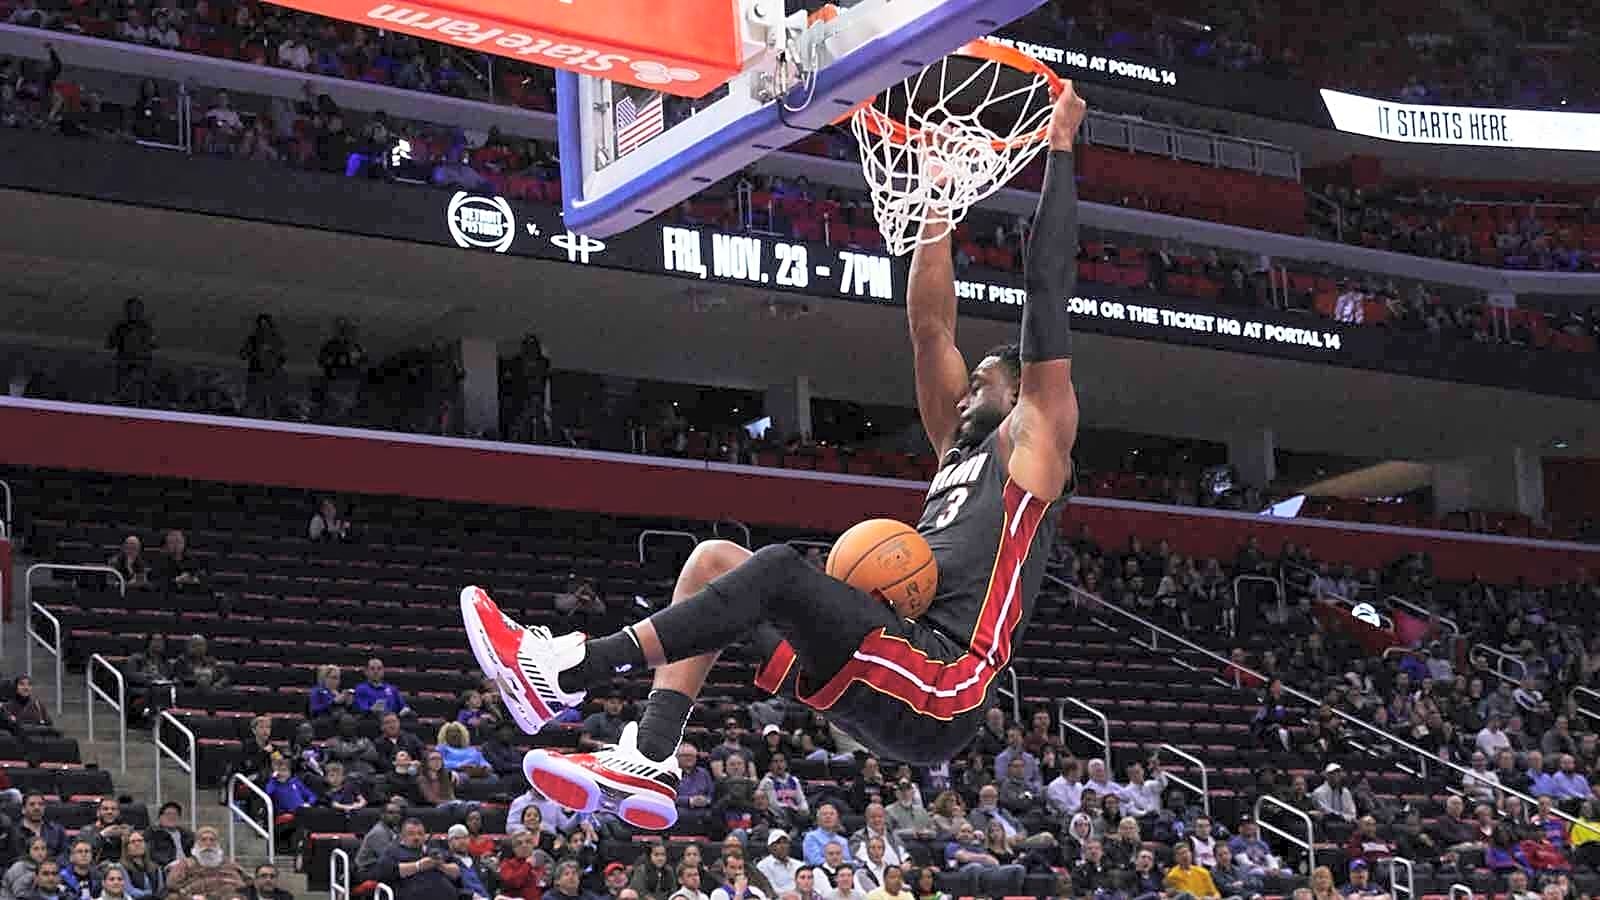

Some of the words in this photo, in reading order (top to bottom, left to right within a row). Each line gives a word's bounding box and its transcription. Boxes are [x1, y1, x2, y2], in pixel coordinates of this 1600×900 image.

[1016, 41, 1065, 63] TICKET
[1066, 52, 1089, 68] HQ
[1089, 57, 1108, 71] AT
[1108, 60, 1161, 82] PORTAL
[1160, 69, 1177, 85] 14
[1378, 106, 1390, 134] IT
[1397, 110, 1463, 139] STARTS
[712, 233, 769, 283] NOV.
[774, 242, 809, 288] 23
[815, 265, 831, 277] -
[838, 251, 893, 300] 7PM
[953, 280, 986, 300] ISIT
[988, 285, 1027, 306] PIST
[1099, 301, 1125, 319] OR
[1126, 305, 1158, 324] THE
[1159, 309, 1215, 332] TICKET
[1216, 317, 1241, 336] HQ
[1243, 321, 1263, 339] AT
[1264, 325, 1323, 348] PORTAL
[1323, 333, 1341, 350] 14
[935, 487, 968, 528] 3
